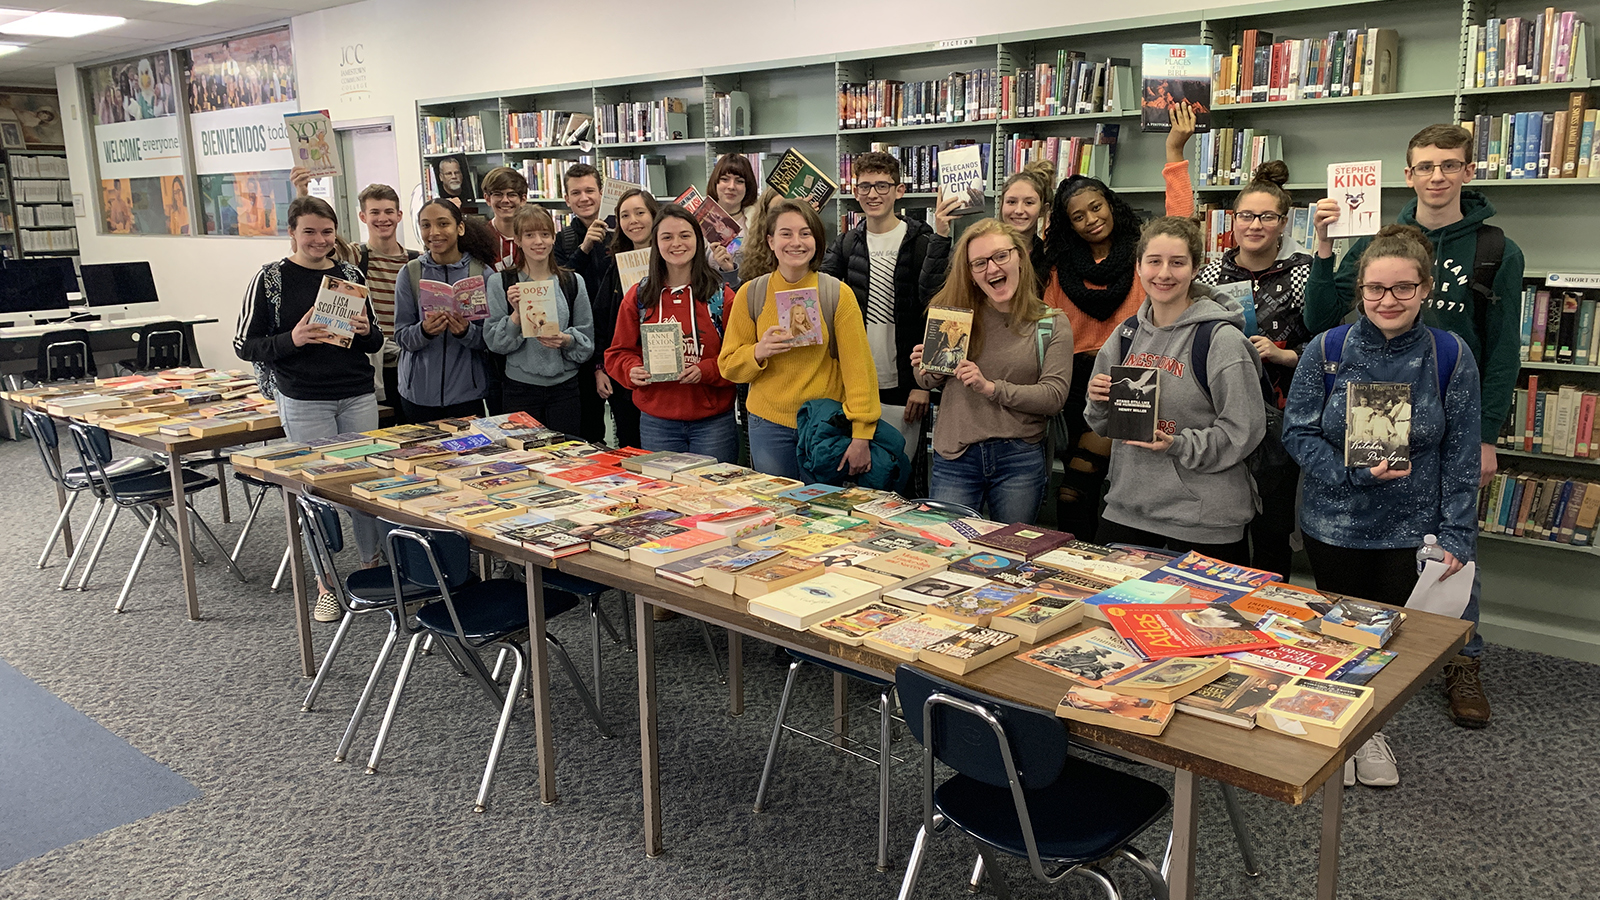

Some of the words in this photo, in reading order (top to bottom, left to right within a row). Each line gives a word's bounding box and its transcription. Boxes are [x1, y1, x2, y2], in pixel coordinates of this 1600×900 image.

[942, 39, 974, 47] FICTION
[340, 44, 364, 66] JCC
[1170, 49, 1186, 57] LIFE
[340, 66, 366, 77] JAMESTOWN
[340, 75, 366, 84] COMMUNITY
[342, 82, 368, 91] COLLEGE
[1572, 95, 1582, 107] THE
[1570, 108, 1580, 125] SWISS
[290, 120, 328, 138] YOU
[201, 124, 266, 156] BIENVENIDOS
[267, 125, 289, 142] todo
[1568, 126, 1579, 146] FAMILY
[103, 137, 143, 164] WELCOME
[142, 136, 180, 153] everyone
[770, 153, 797, 188] NELSON
[942, 161, 979, 173] PELECANOS
[1335, 166, 1376, 175] STEPHEN
[777, 160, 804, 195] DEMILLE
[942, 170, 980, 185] DRAMA
[1334, 174, 1376, 188] KING
[607, 188, 622, 196] ALBR
[608, 182, 633, 190] MADELE
[950, 180, 973, 194] CITY
[1358, 210, 1378, 229] IT
[618, 250, 650, 270] BARBAR
[522, 285, 550, 296] oogy
[333, 295, 349, 308] LISA
[313, 314, 334, 326] THINK
[1272, 321, 1279, 330] B
[1125, 353, 1185, 378] MESTOWN
[1351, 440, 1384, 451] Kitchen
[1107, 594, 1139, 604] BONE
[1134, 614, 1182, 650] Atlas
[1284, 654, 1327, 671] United
